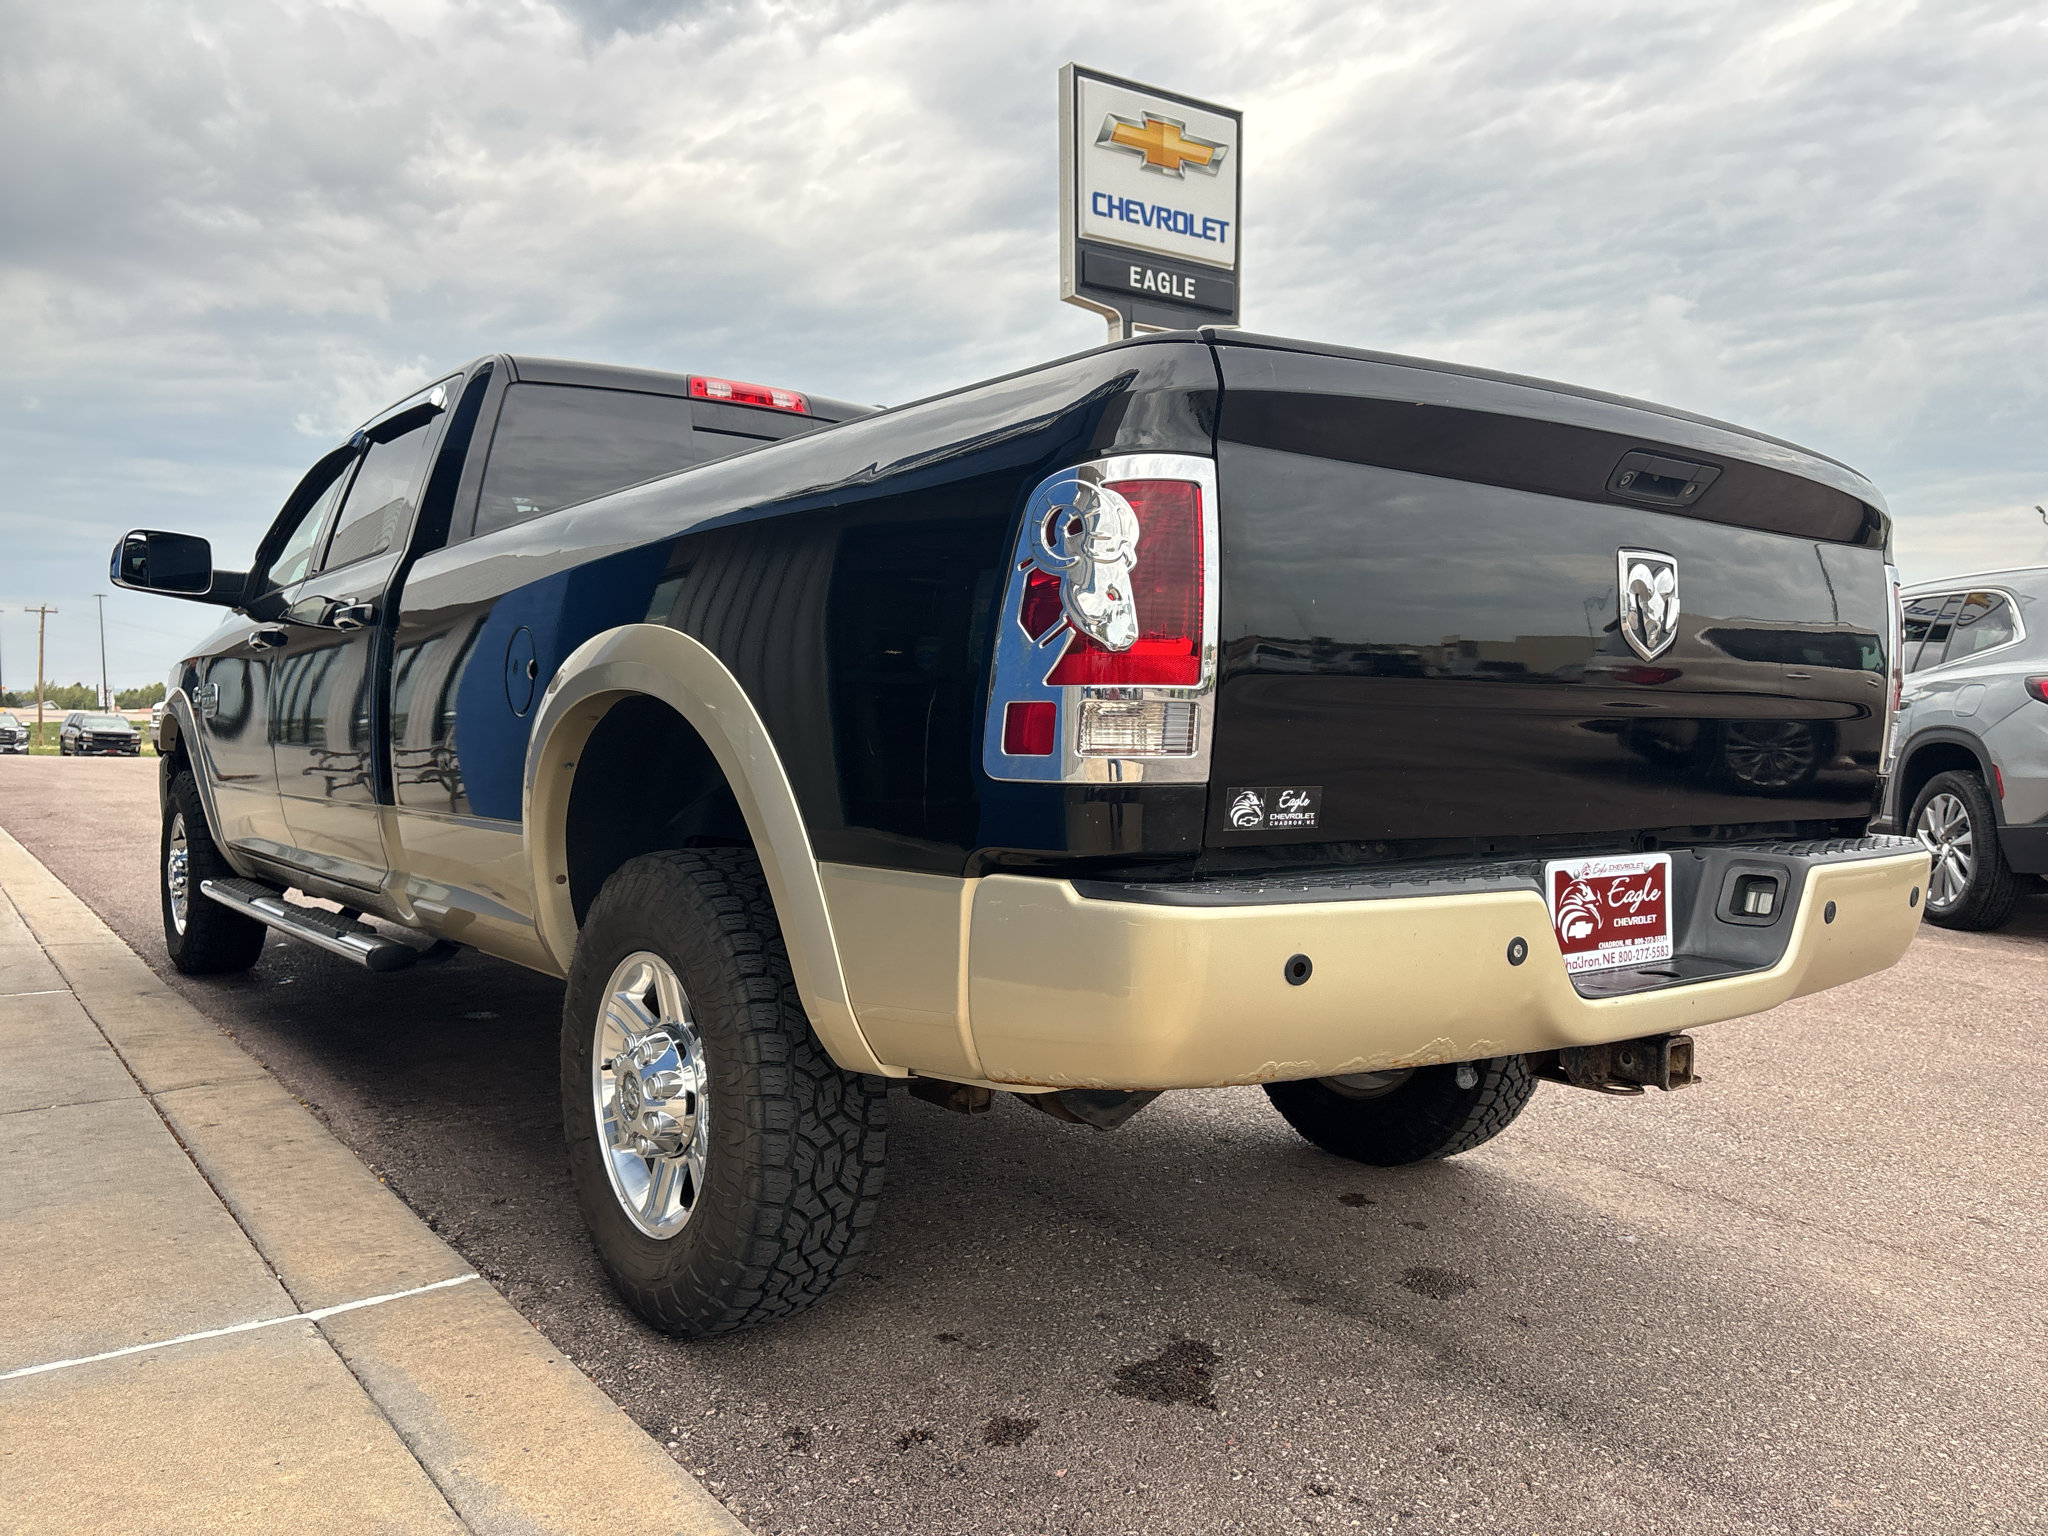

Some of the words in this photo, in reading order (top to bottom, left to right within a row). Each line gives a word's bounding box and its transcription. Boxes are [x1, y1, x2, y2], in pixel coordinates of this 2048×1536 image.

[1092, 191, 1230, 243] CHEVROLET
[1130, 265, 1196, 299] EAGLE
[1279, 790, 1311, 812] Eagle
[1609, 862, 1644, 871] CHEVROLET
[1607, 876, 1662, 913] Eagle
[1613, 914, 1657, 927] CHEVROLET
[1565, 954, 1602, 970] hadron,
[1602, 952, 1615, 964] NE
[1618, 944, 1669, 963] 800-272-5583
